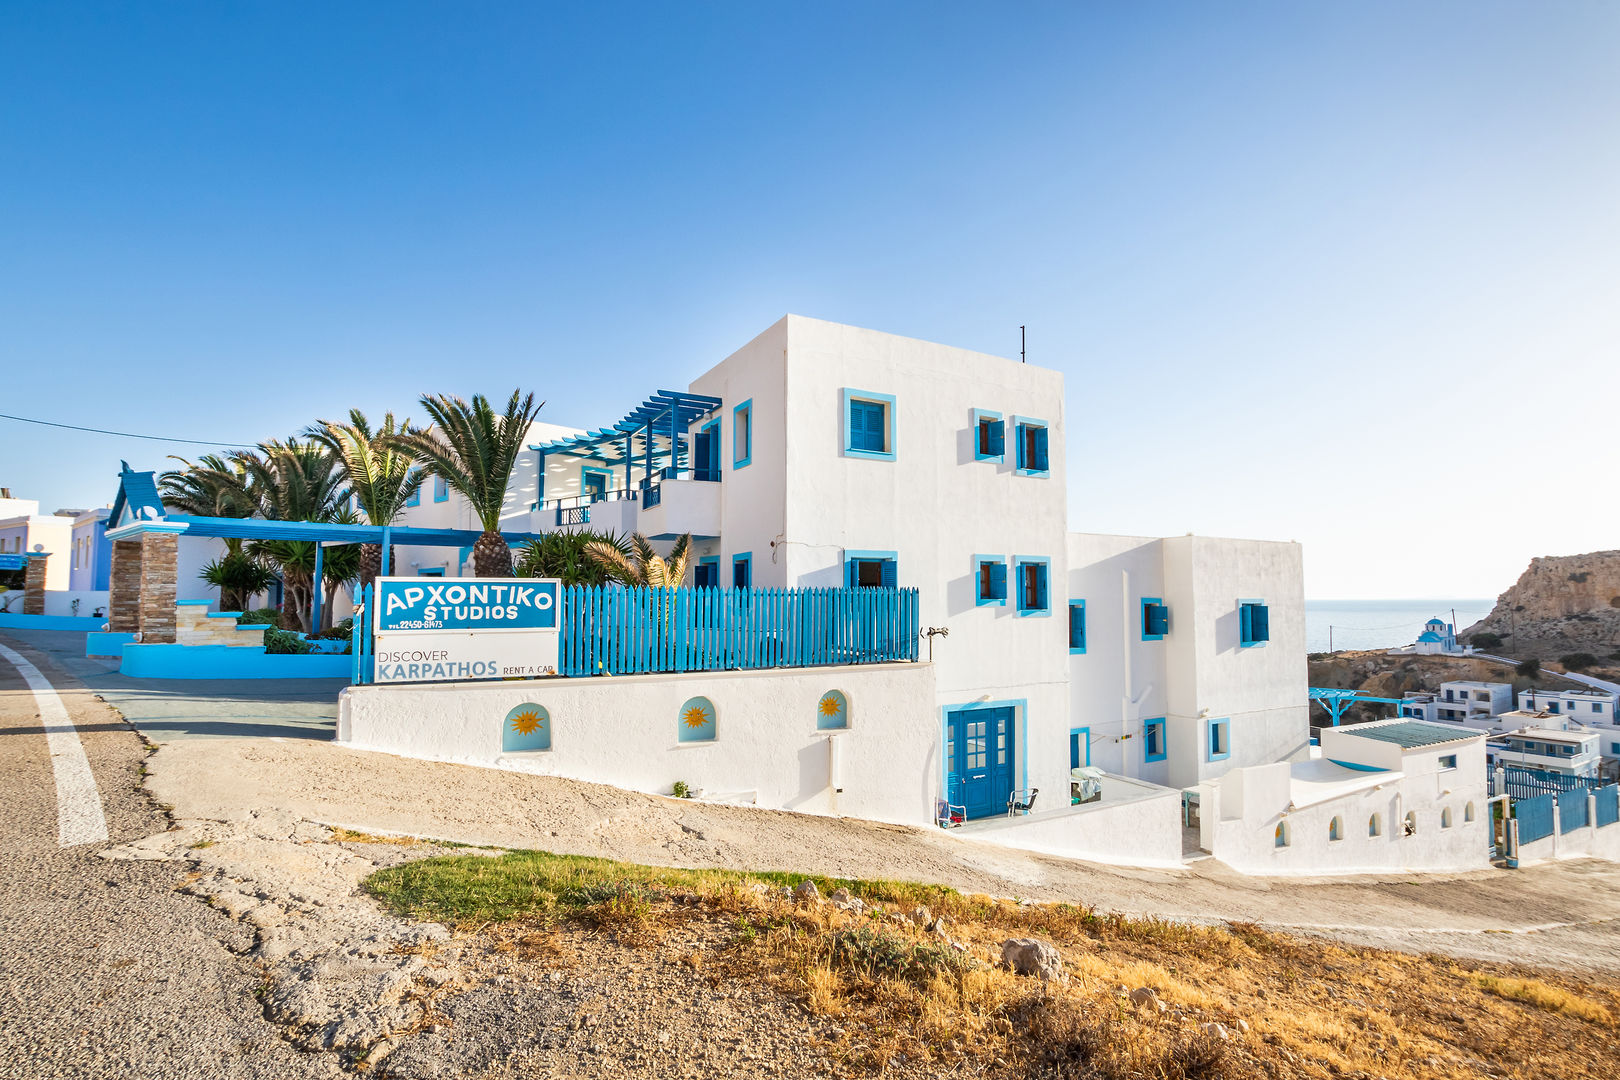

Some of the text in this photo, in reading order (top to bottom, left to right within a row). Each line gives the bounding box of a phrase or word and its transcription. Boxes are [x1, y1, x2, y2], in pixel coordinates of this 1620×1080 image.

[423, 605, 519, 621] STUDIOS
[378, 650, 448, 663] DISCOVER
[378, 660, 497, 680] KARPATHOS
[503, 666, 525, 675] RENT
